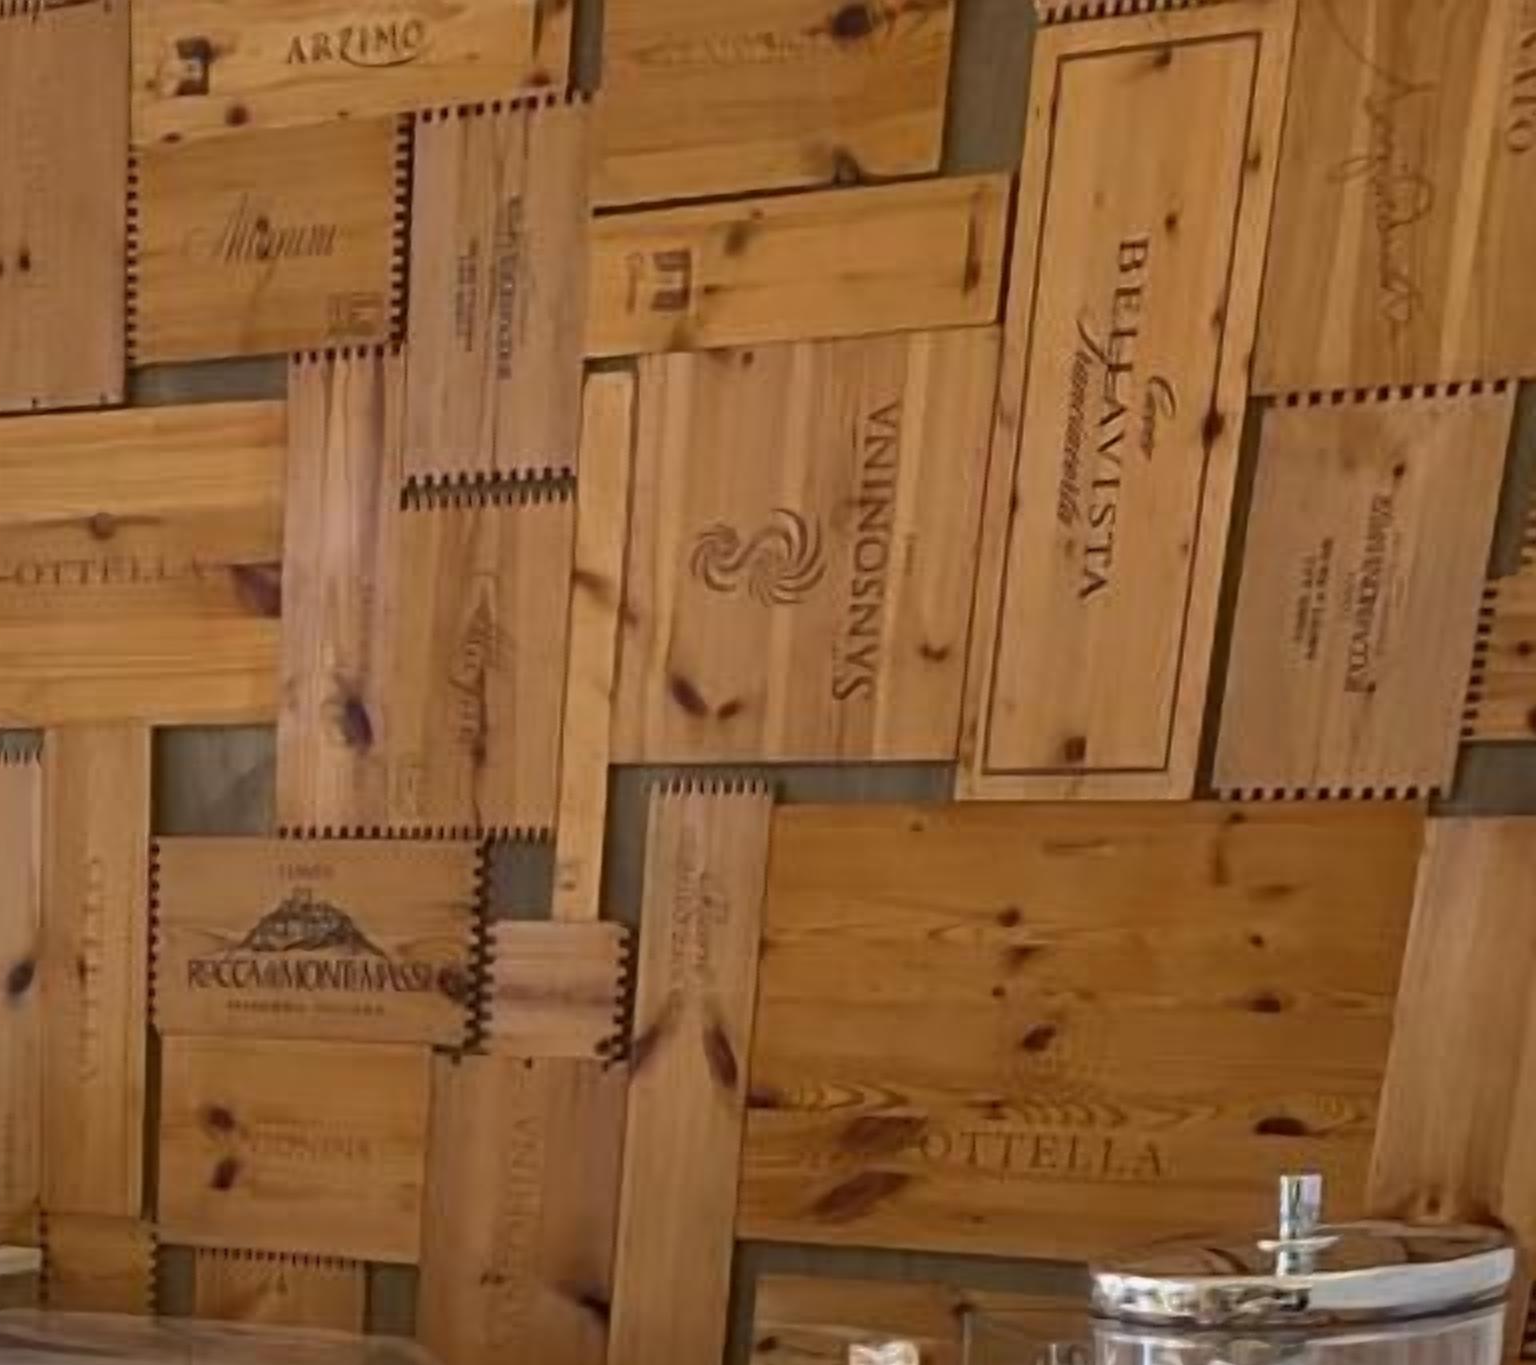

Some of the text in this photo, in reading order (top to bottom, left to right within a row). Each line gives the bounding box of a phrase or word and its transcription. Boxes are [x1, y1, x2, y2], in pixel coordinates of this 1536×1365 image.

[831, 402, 898, 701] SANSONINA
[1077, 238, 1150, 599] BELLAVISTA
[919, 1131, 1163, 1178] OTTELLA
